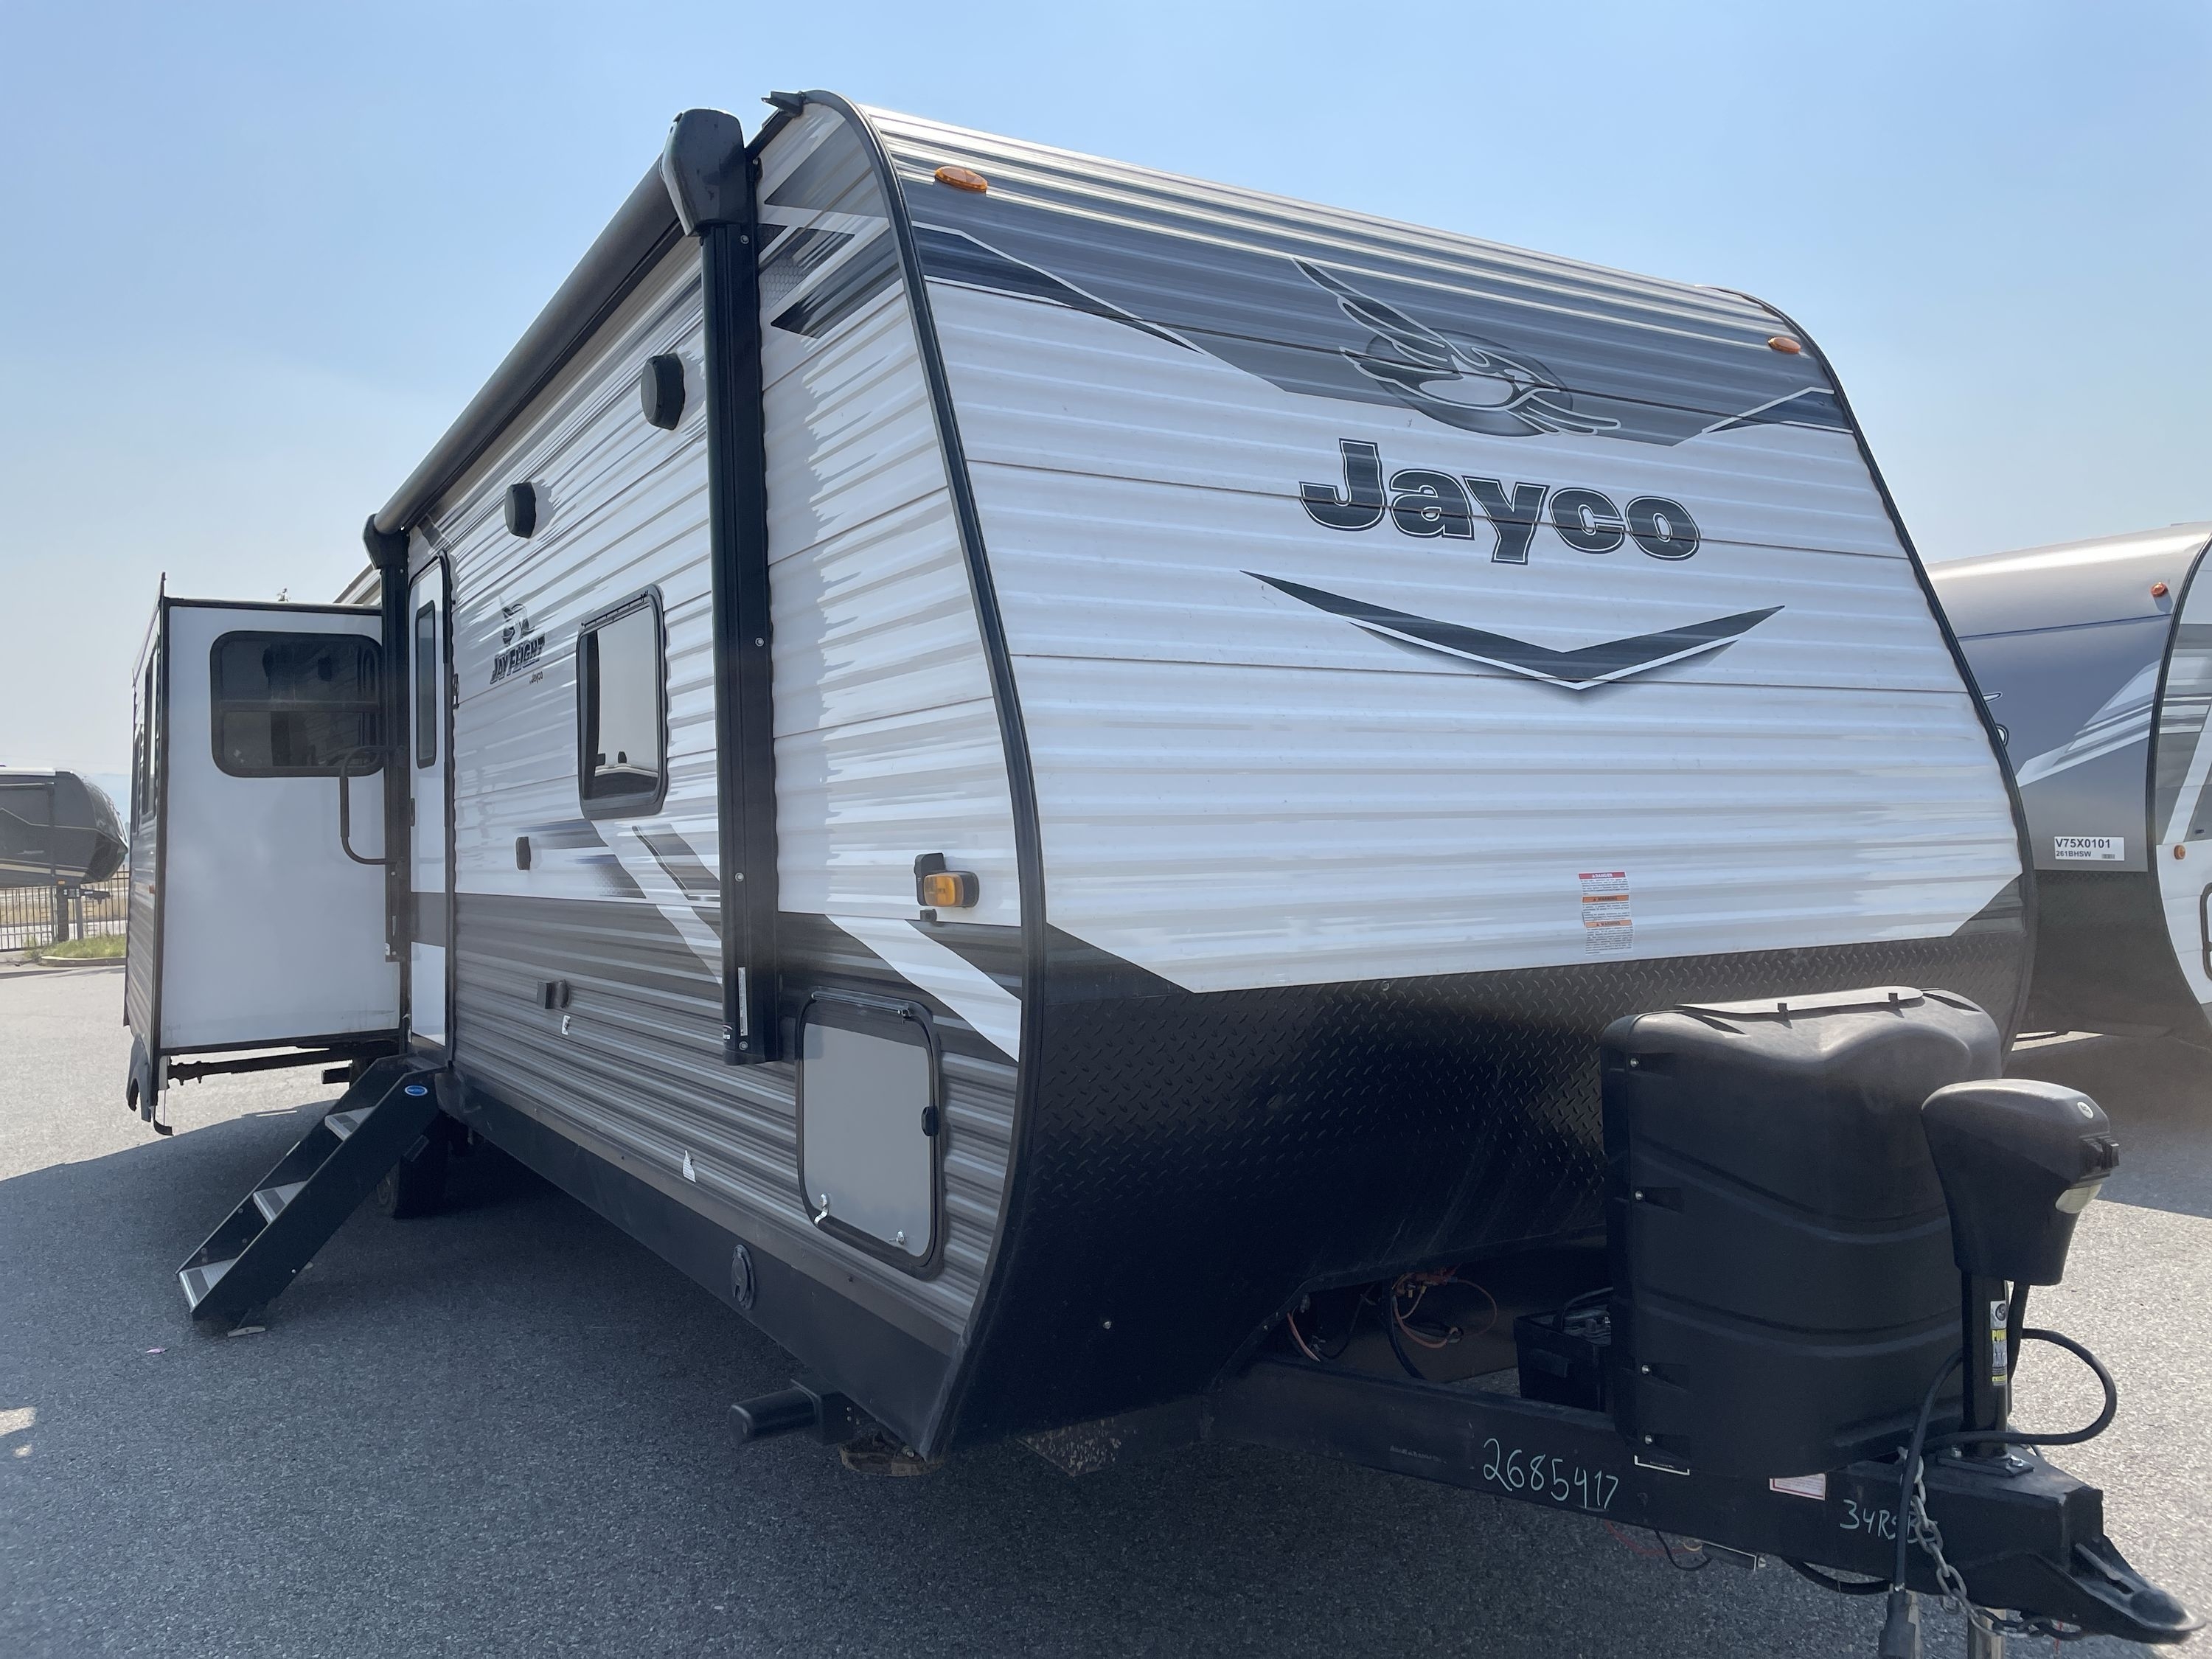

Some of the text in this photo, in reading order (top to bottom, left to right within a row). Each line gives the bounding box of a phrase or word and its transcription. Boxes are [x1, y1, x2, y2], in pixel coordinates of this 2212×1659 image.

[1298, 438, 1700, 566] Jayco
[2055, 838, 2111, 849] V75X0101
[1482, 1437, 1620, 1510] 2685417
